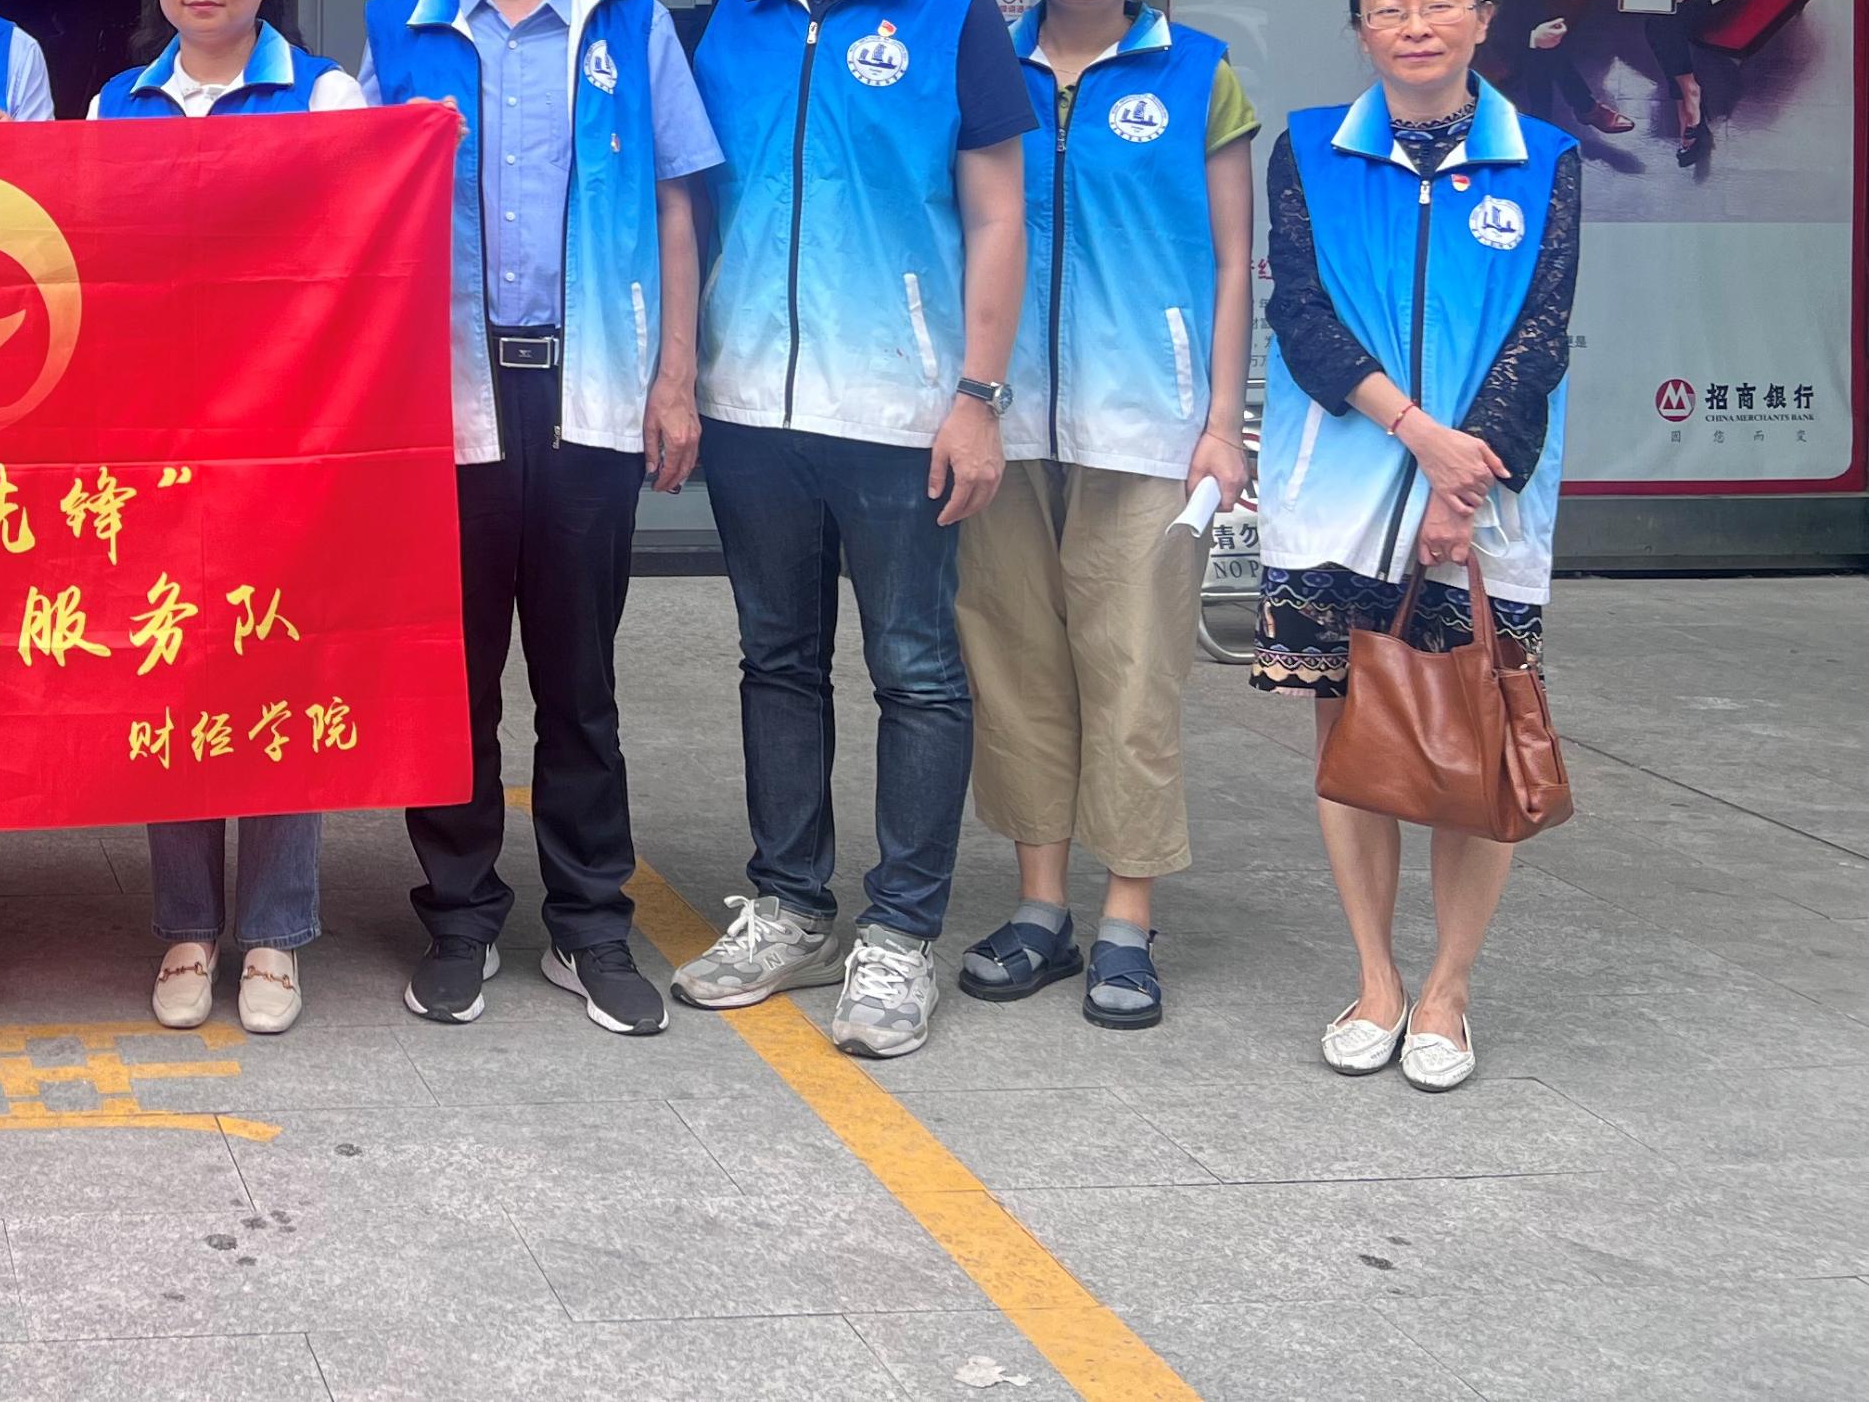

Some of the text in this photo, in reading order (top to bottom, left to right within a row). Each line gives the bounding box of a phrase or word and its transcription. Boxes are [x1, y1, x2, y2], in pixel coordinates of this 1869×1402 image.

[1705, 413, 1815, 423] CHINA MERCHANTS BANK
[1213, 560, 1243, 579] NO
[128, 695, 359, 771] 财经学院
